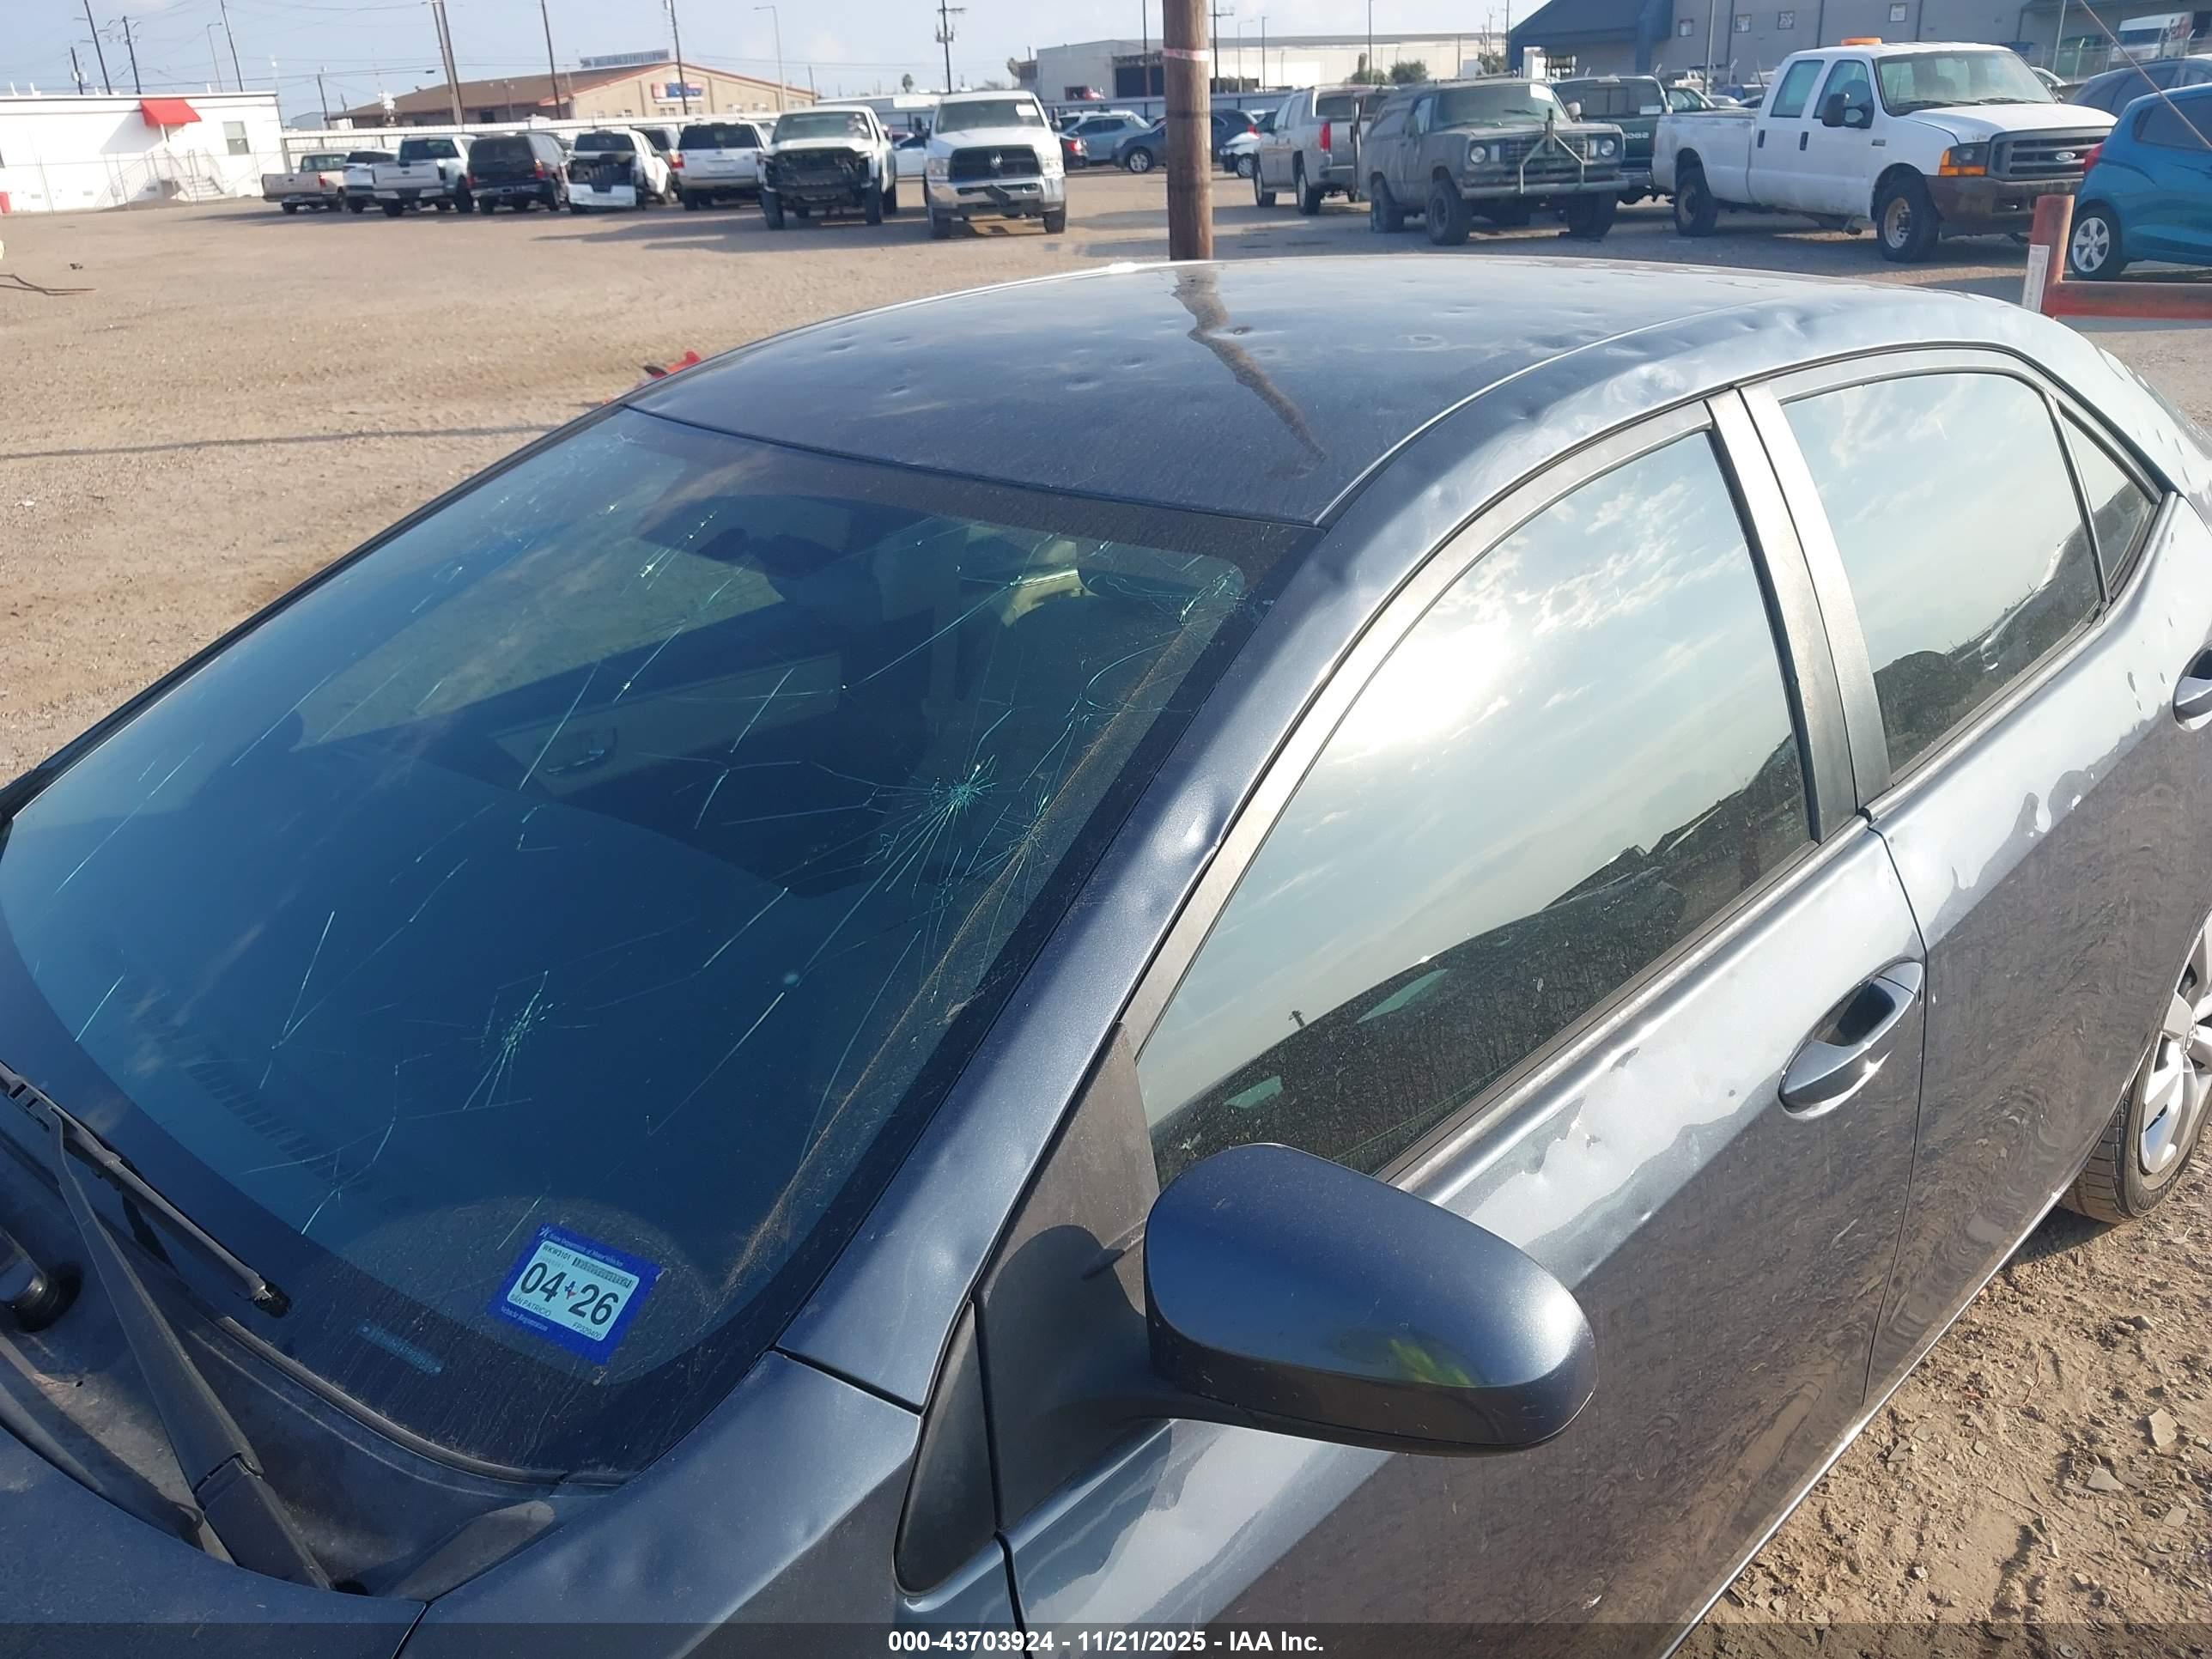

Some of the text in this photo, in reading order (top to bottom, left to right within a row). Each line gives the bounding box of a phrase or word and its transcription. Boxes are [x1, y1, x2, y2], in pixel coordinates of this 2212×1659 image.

[509, 1293, 551, 1316] SAN PATRICIO
[520, 1262, 618, 1326] 04 26
